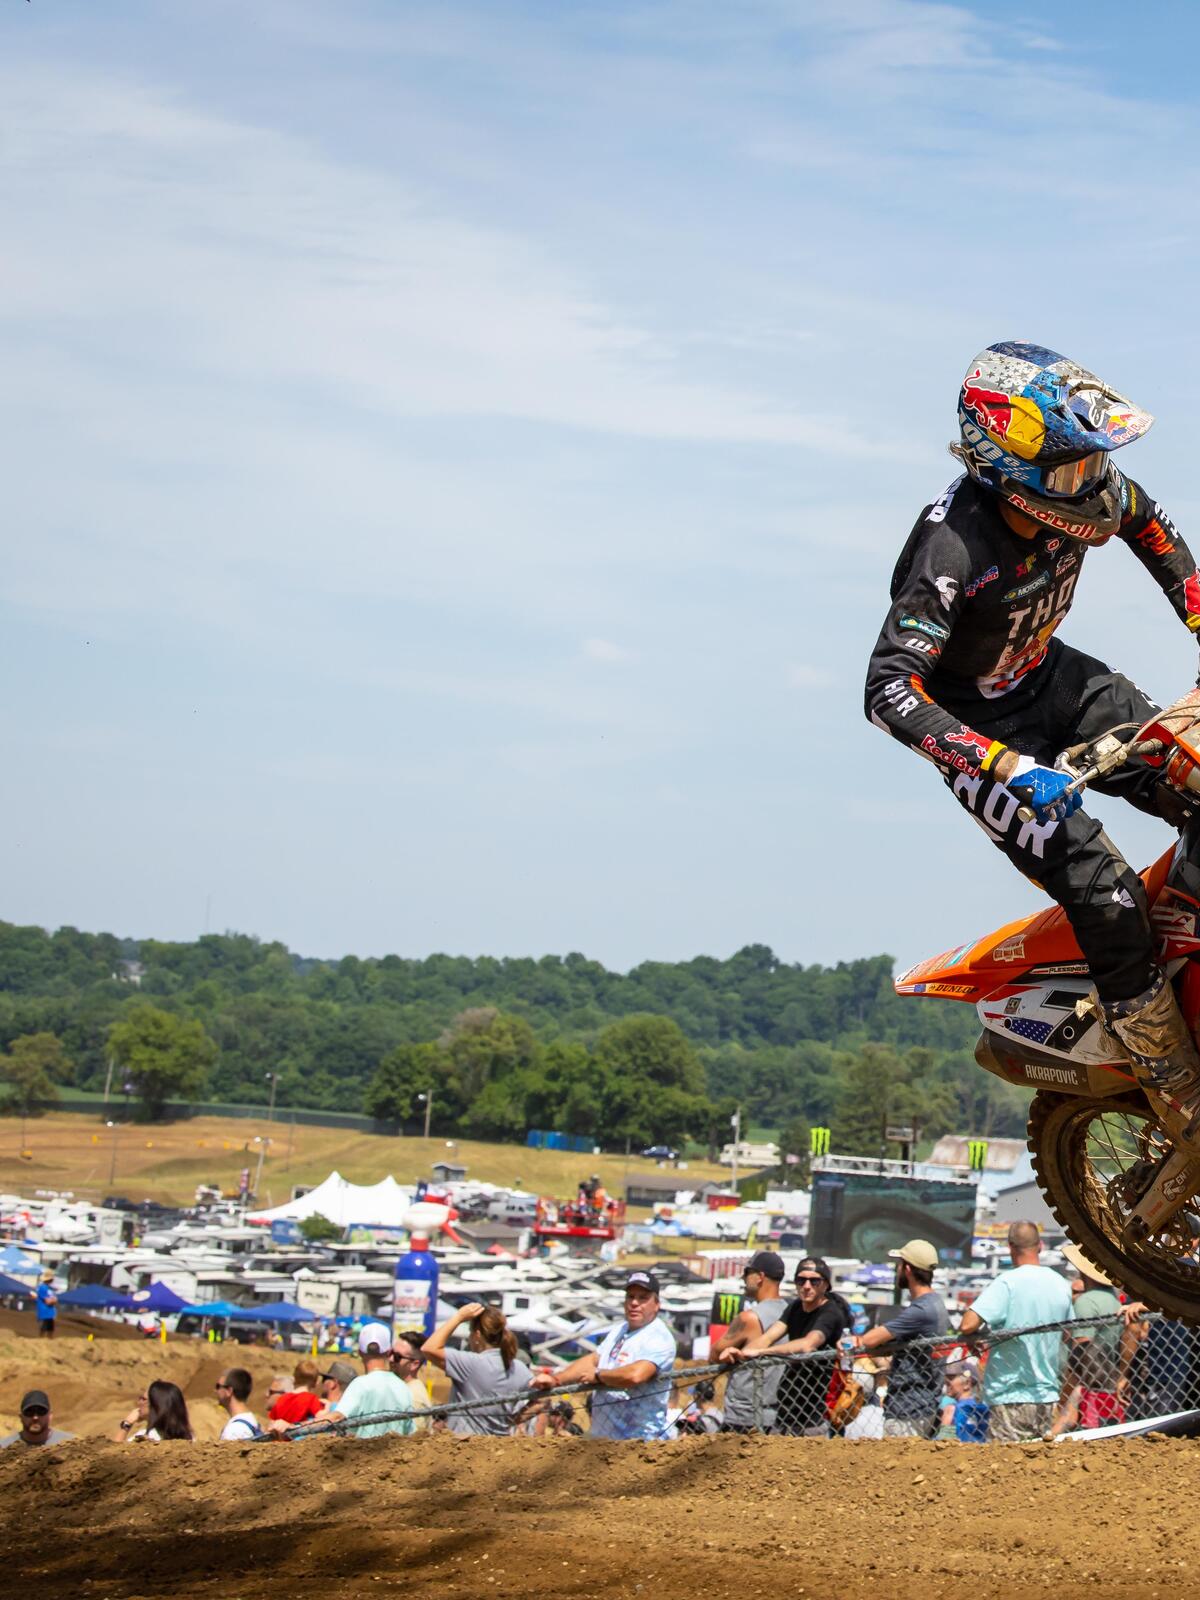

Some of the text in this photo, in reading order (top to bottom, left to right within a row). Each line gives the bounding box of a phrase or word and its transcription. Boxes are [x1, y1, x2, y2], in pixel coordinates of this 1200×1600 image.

[1007, 573, 1077, 639] THO
[920, 734, 957, 764] Red
[953, 771, 1060, 859] HOR
[934, 983, 979, 994] DUNLOP
[1025, 1064, 1079, 1086] AKRAPOVIČ
